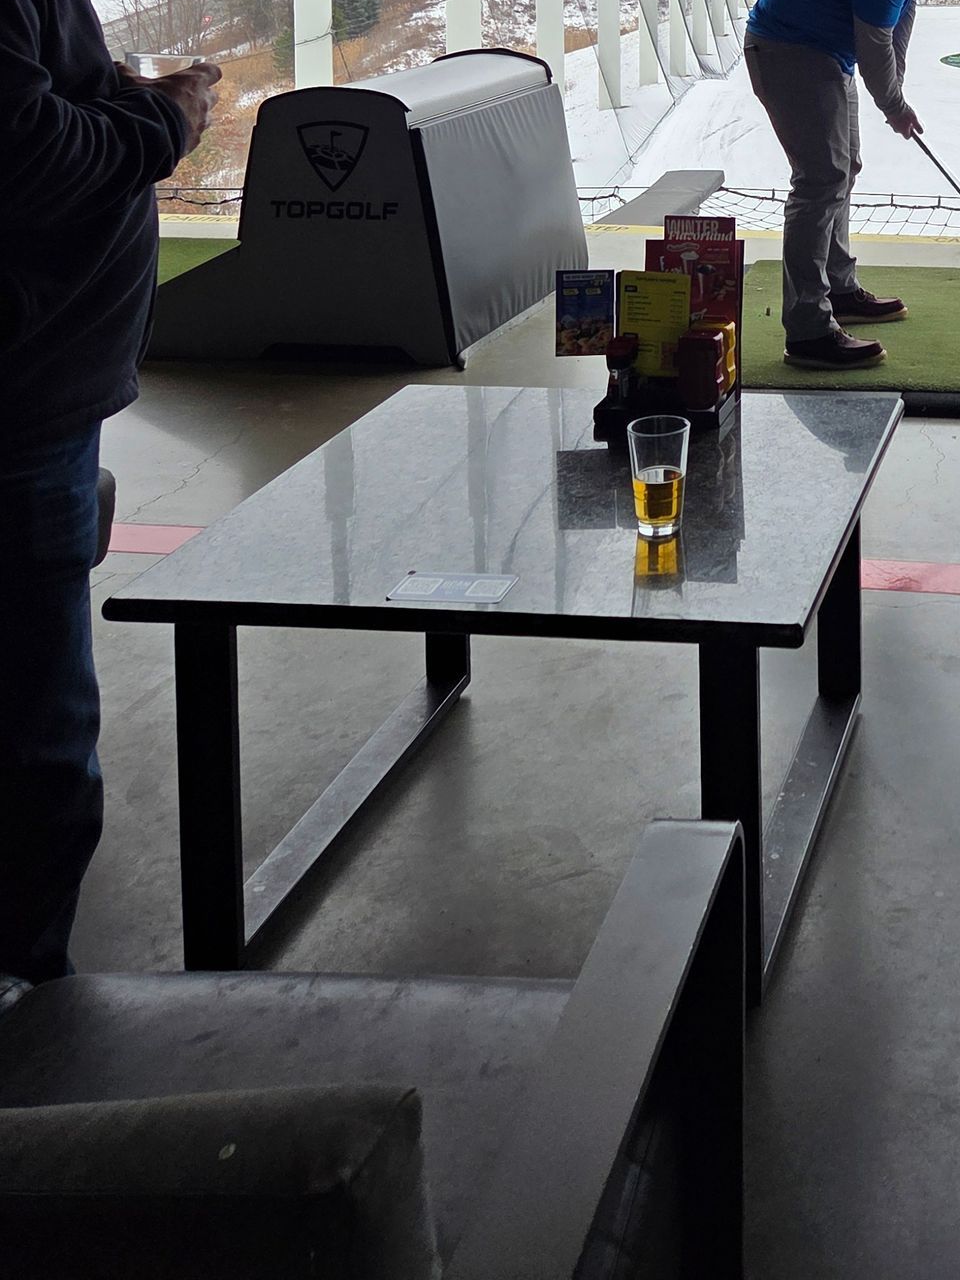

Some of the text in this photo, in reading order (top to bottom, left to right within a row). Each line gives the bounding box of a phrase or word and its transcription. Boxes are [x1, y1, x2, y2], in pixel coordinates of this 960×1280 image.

[270, 200, 399, 221] TOPGOLF
[666, 219, 719, 235] WINTER
[667, 231, 734, 241] Flavorland
